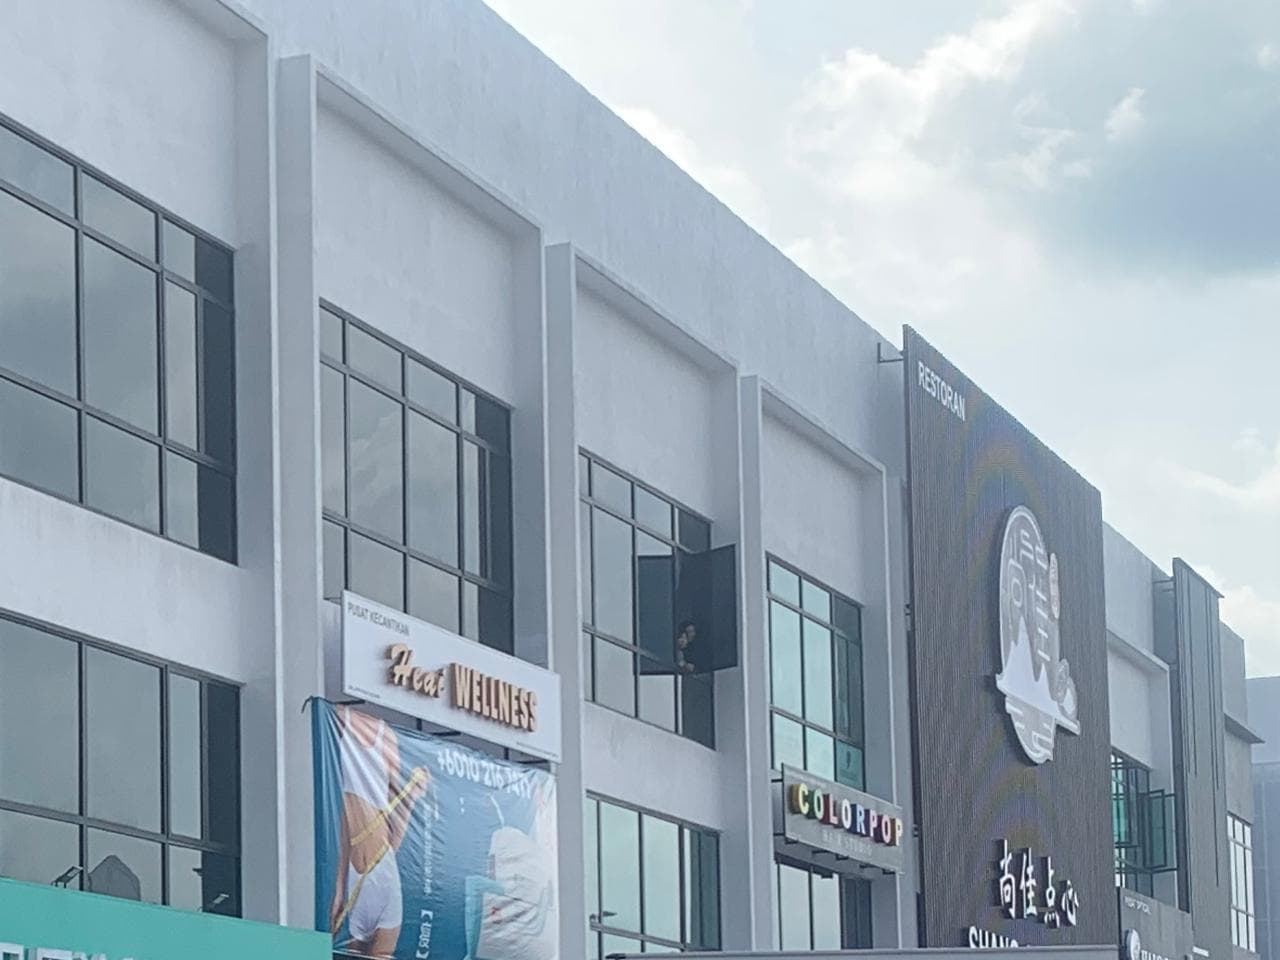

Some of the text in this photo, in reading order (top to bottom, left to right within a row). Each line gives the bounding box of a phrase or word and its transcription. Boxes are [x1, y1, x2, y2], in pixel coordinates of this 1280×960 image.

[918, 361, 966, 422] RESTORAN
[449, 663, 538, 733] WELLNESS
[794, 782, 903, 846] COLORPOP
